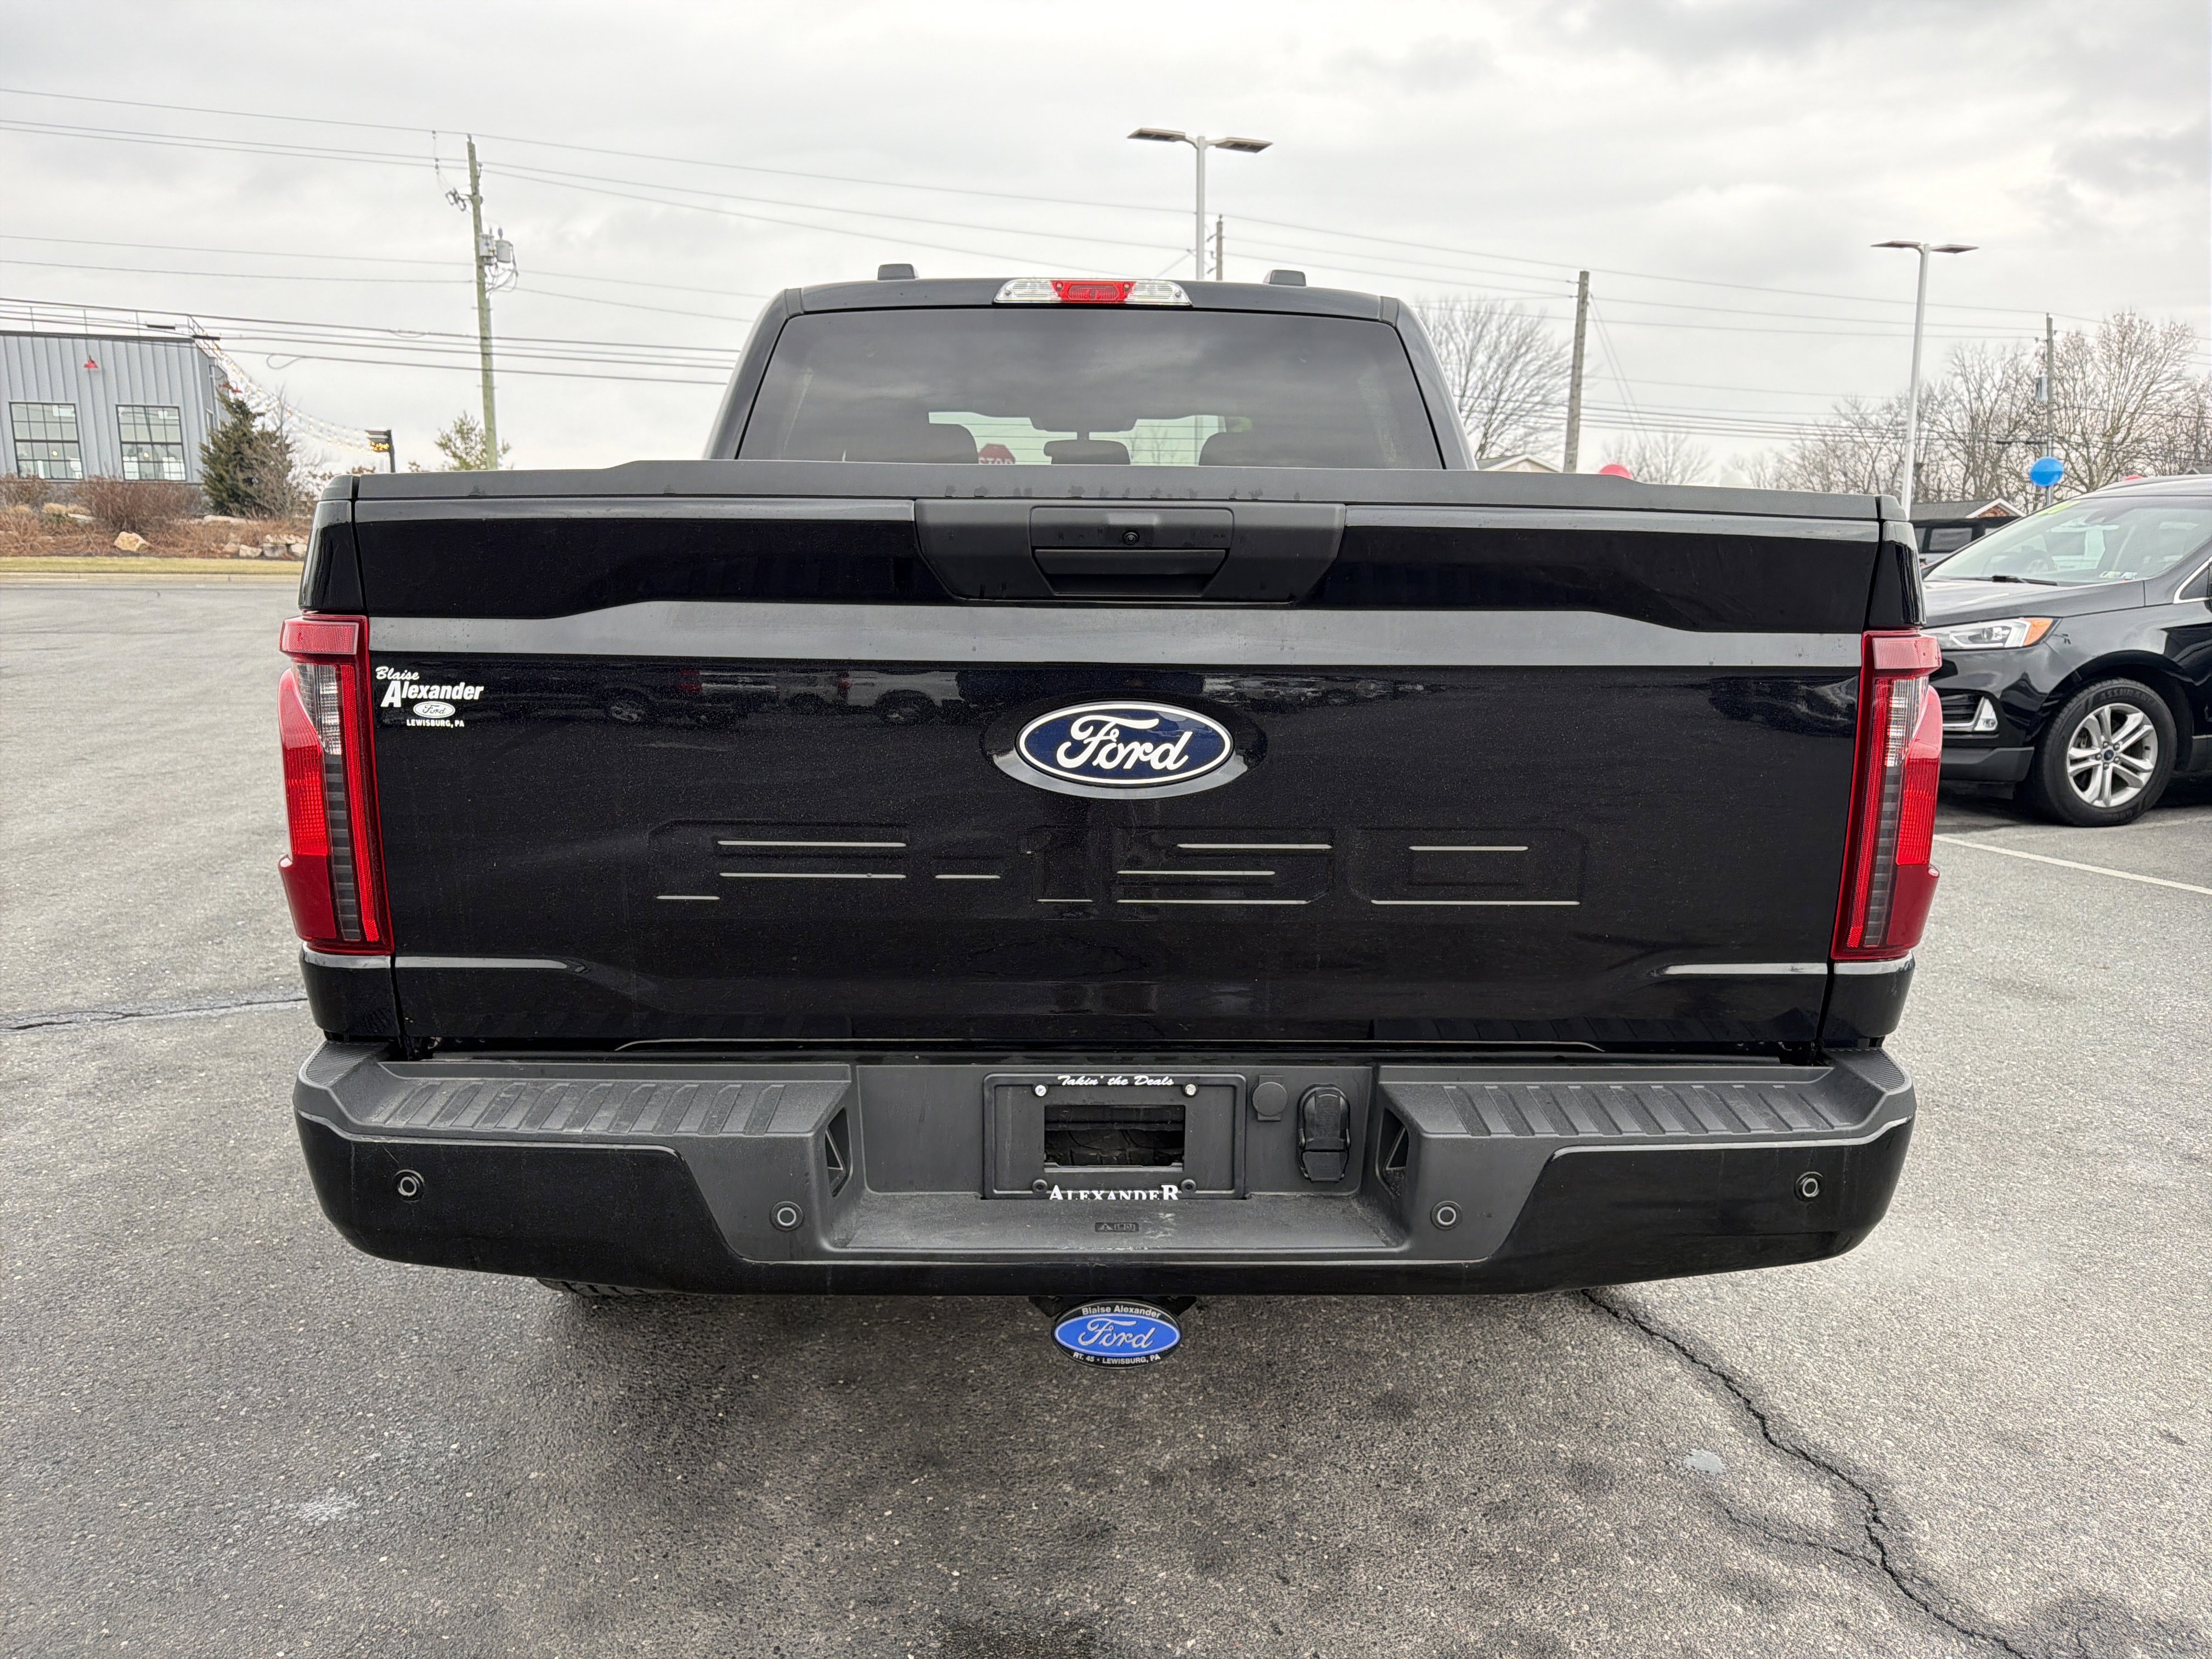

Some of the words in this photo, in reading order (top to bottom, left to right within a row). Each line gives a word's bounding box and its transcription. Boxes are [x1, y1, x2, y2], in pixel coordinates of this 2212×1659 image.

[375, 666, 420, 680] Blaise
[380, 681, 484, 708] Alexander
[422, 704, 446, 714] Ford
[406, 719, 454, 729] LEWISBURG,
[1056, 715, 1193, 770] Ford
[1058, 1075, 1104, 1086] Takin'
[1107, 1075, 1128, 1086] the
[1134, 1075, 1175, 1086] Deals
[1049, 1184, 1179, 1200] ALEXANDER
[1081, 1306, 1111, 1316] Blaise
[1114, 1305, 1161, 1319] Alexander
[1078, 1318, 1156, 1348] Ford
[1073, 1351, 1085, 1361] RT.
[1085, 1355, 1095, 1363] 45
[1102, 1356, 1149, 1365] LEWISBURG,
[1150, 1353, 1161, 1362] PA
